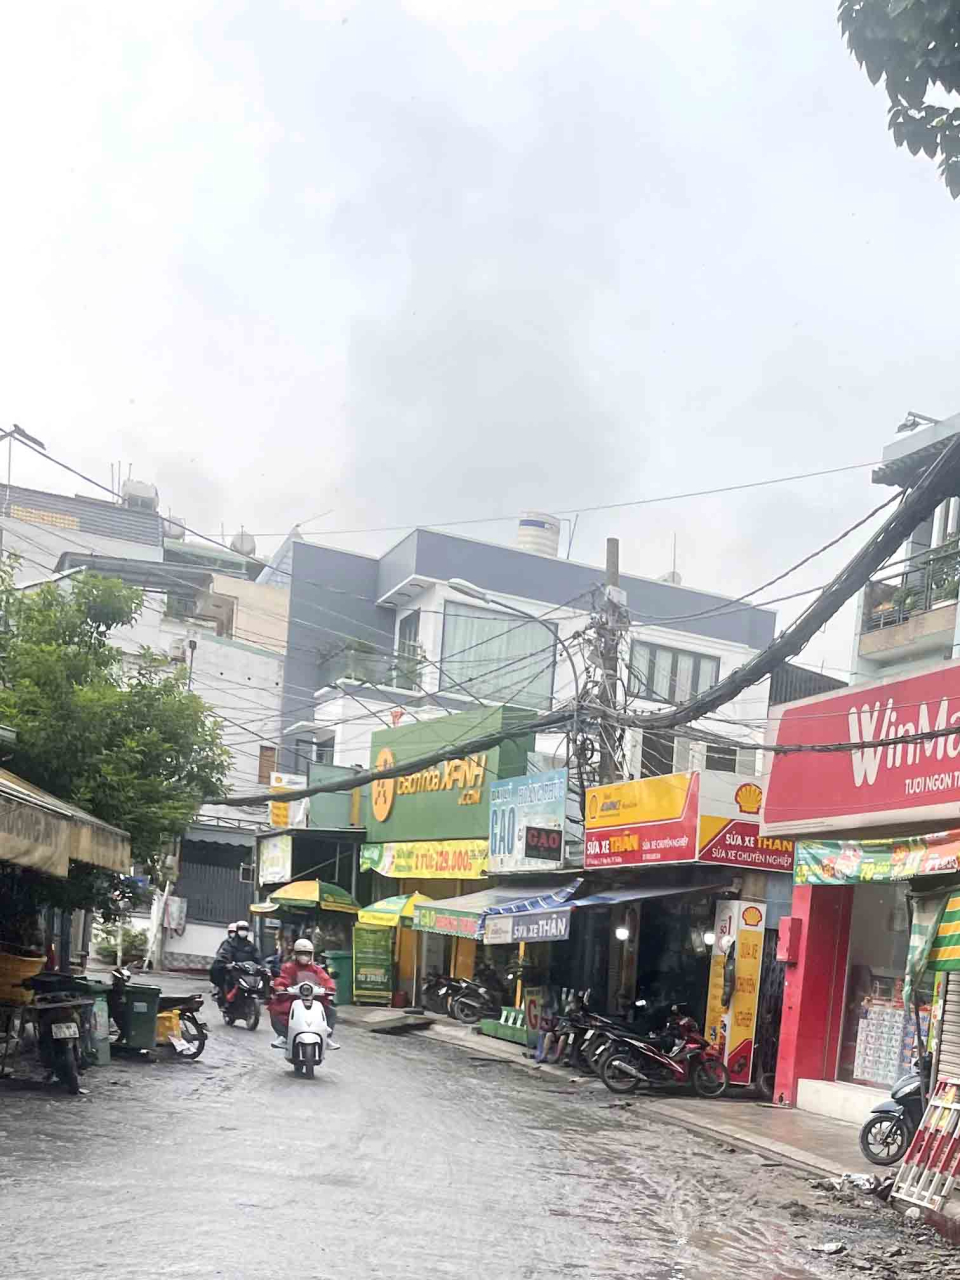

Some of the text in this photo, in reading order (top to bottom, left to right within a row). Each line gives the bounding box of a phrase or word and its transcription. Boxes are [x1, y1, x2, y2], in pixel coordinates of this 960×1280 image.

[440, 752, 487, 791] XANH
[926, 772, 952, 792] NGON
[601, 839, 609, 854] XE
[609, 830, 640, 854] THÂN
[725, 831, 743, 847] SỬA
[744, 836, 755, 848] XE
[727, 850, 737, 860] XE
[529, 924, 539, 937] XE
[539, 913, 566, 937] THÂN
